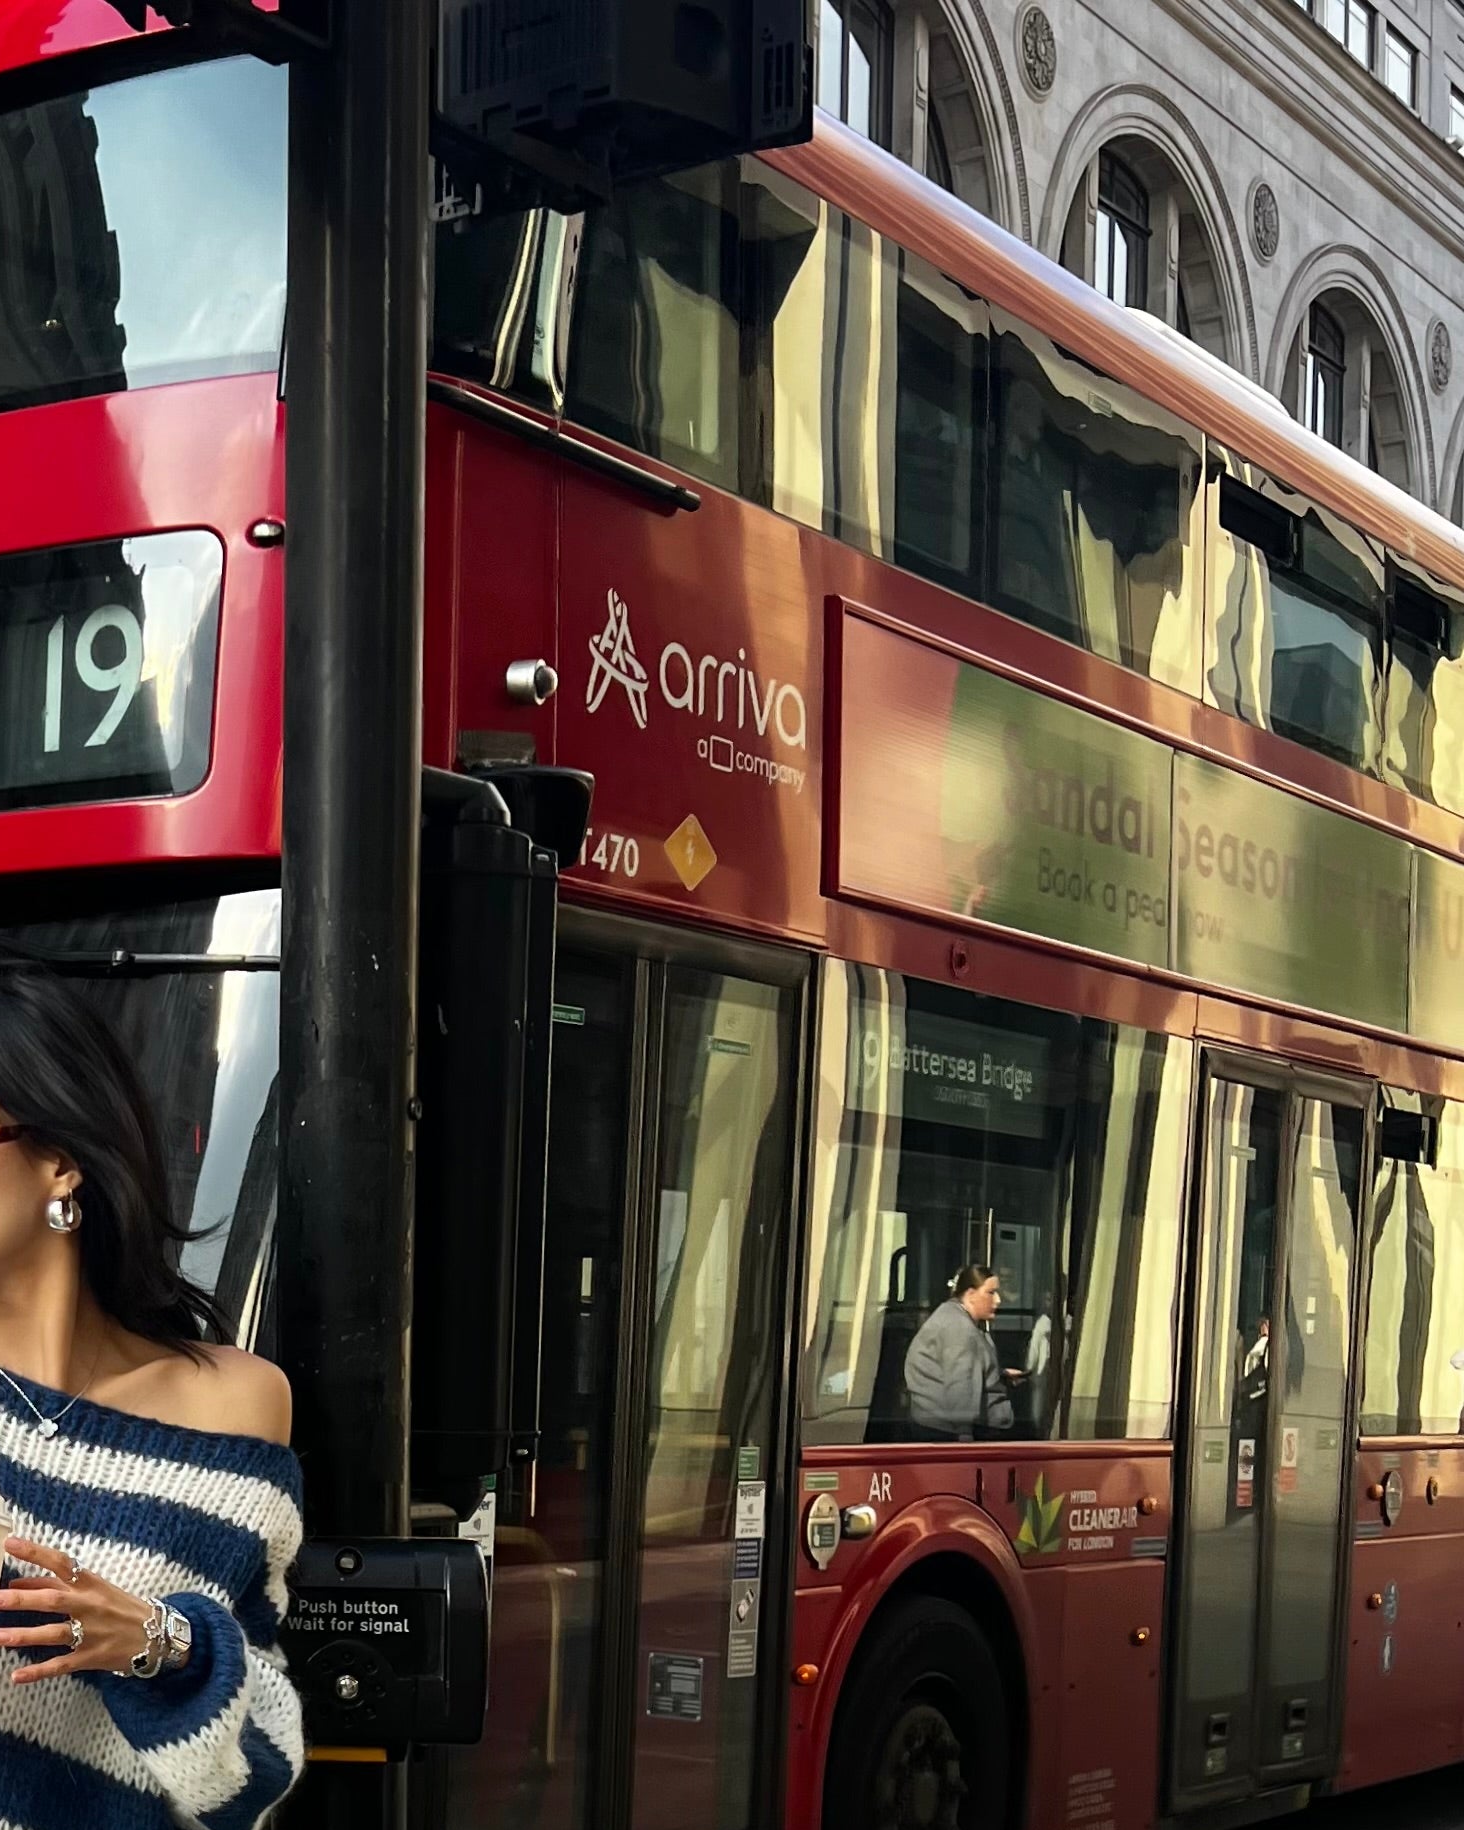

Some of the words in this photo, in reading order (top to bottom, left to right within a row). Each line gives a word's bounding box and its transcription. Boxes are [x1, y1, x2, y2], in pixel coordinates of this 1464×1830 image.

[44, 604, 142, 753] 19
[659, 641, 806, 751] arriva
[697, 739, 708, 759] a
[736, 751, 806, 795] company
[982, 1053, 1033, 1101] Bridge
[868, 1471, 893, 1502] AR
[288, 1617, 325, 1631] Wait
[331, 1617, 354, 1632] for
[360, 1618, 410, 1635] signal
[298, 1599, 337, 1614] Push
[343, 1600, 399, 1615] button
